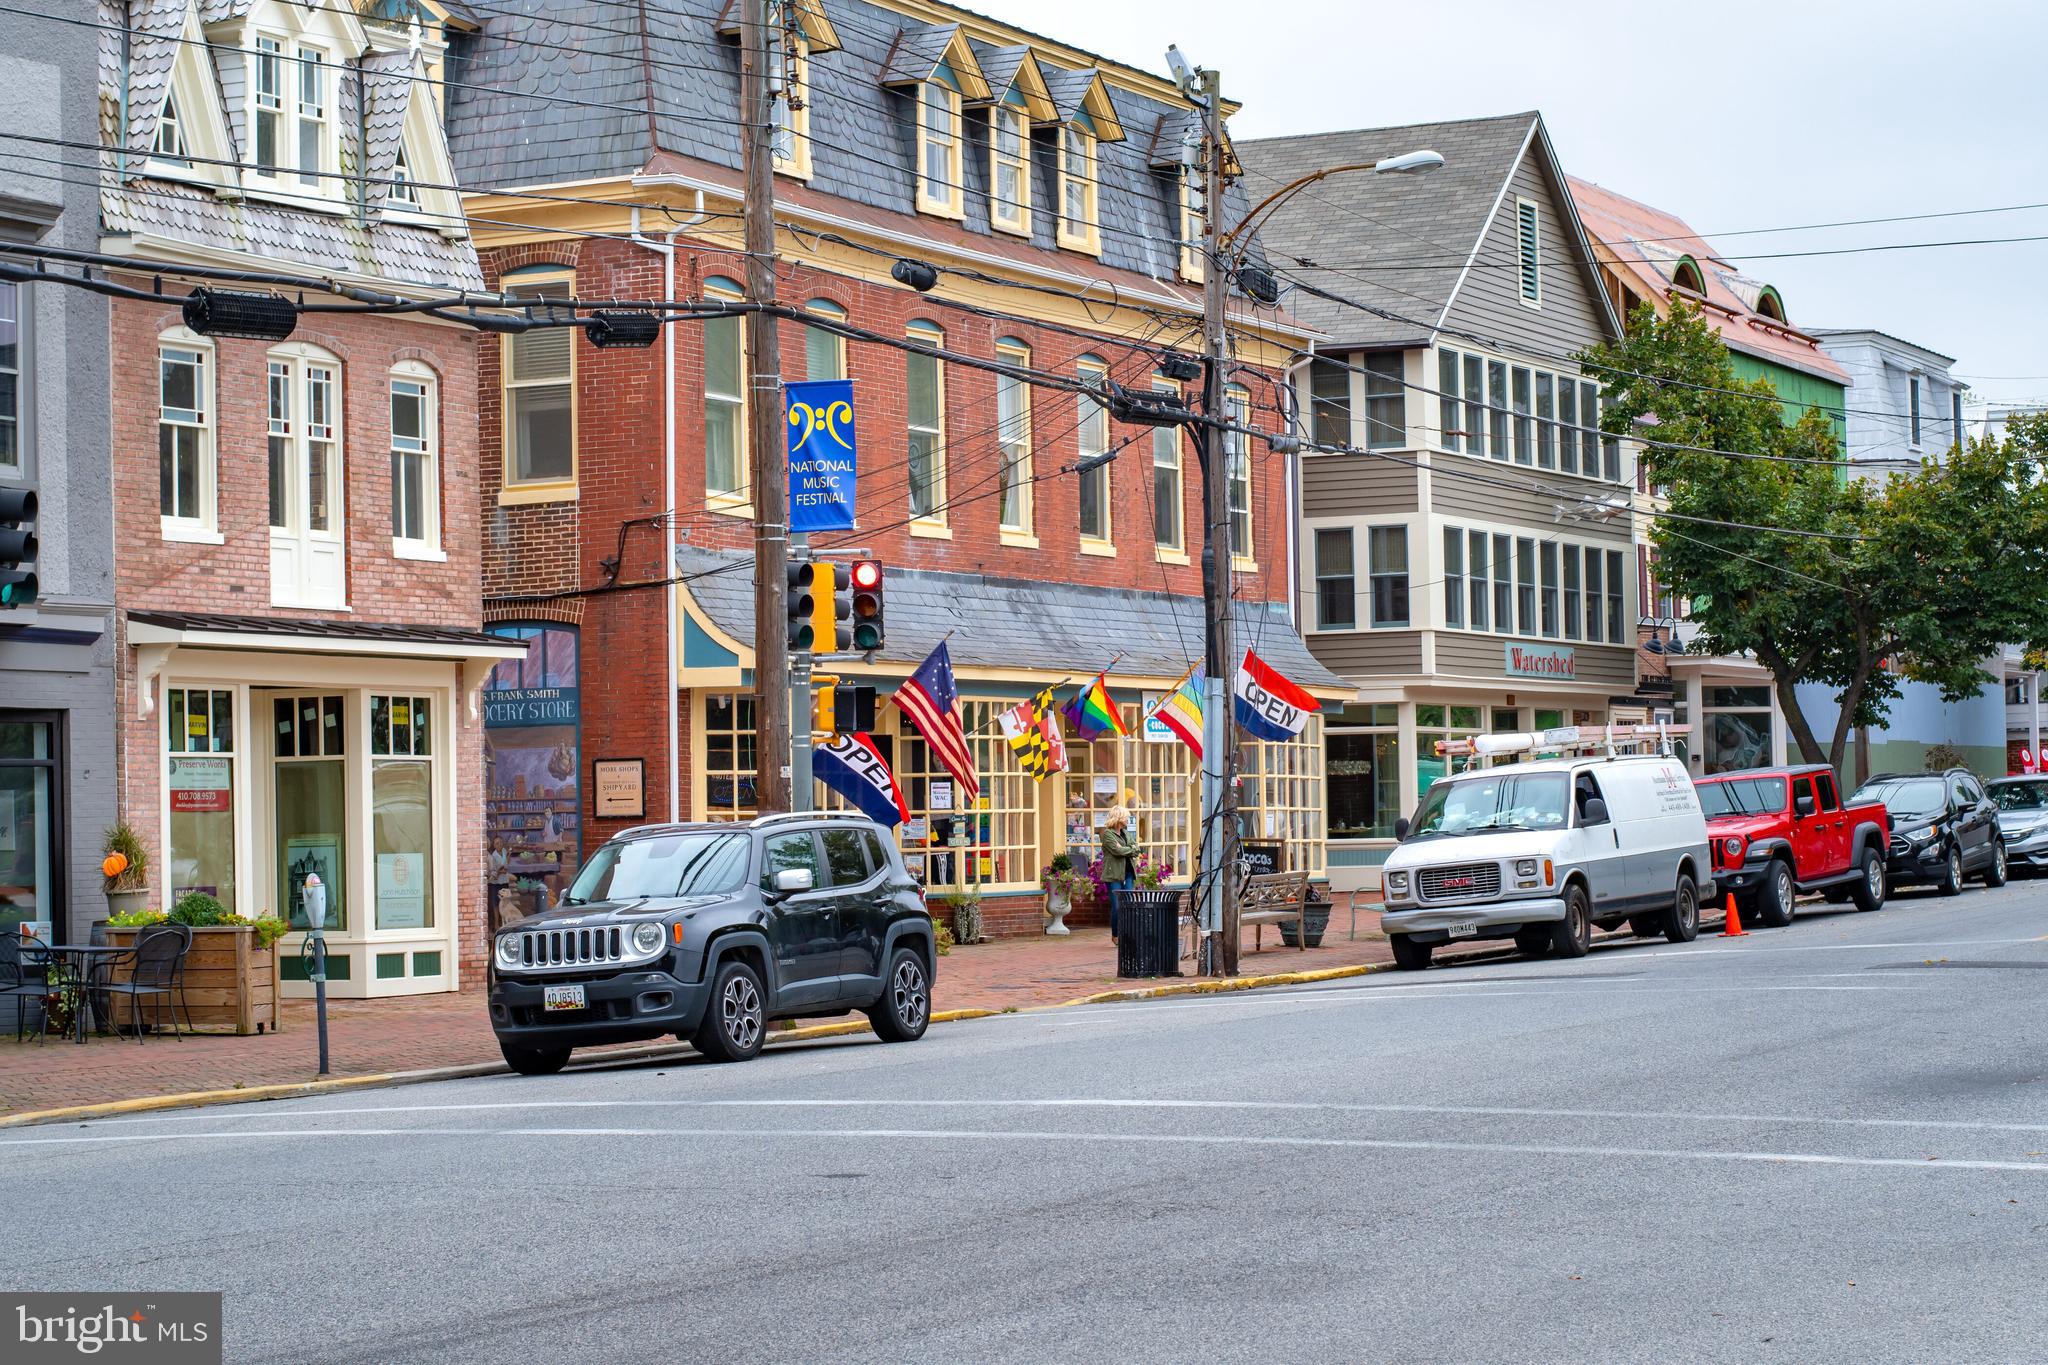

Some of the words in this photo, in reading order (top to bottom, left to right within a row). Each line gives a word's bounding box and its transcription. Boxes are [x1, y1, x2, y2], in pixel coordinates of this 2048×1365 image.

[790, 459, 854, 473] NATIONAL
[803, 476, 840, 489] MUSIC
[796, 492, 848, 506] FESTIVAL
[1511, 647, 1575, 674] Watershed
[490, 690, 524, 701] FRANK
[526, 689, 560, 699] SMITH
[529, 700, 576, 718] STORE
[1245, 681, 1298, 727] OPEN
[178, 760, 206, 769] Preserve
[1443, 878, 1474, 888] GMC
[562, 918, 583, 926] Jeep
